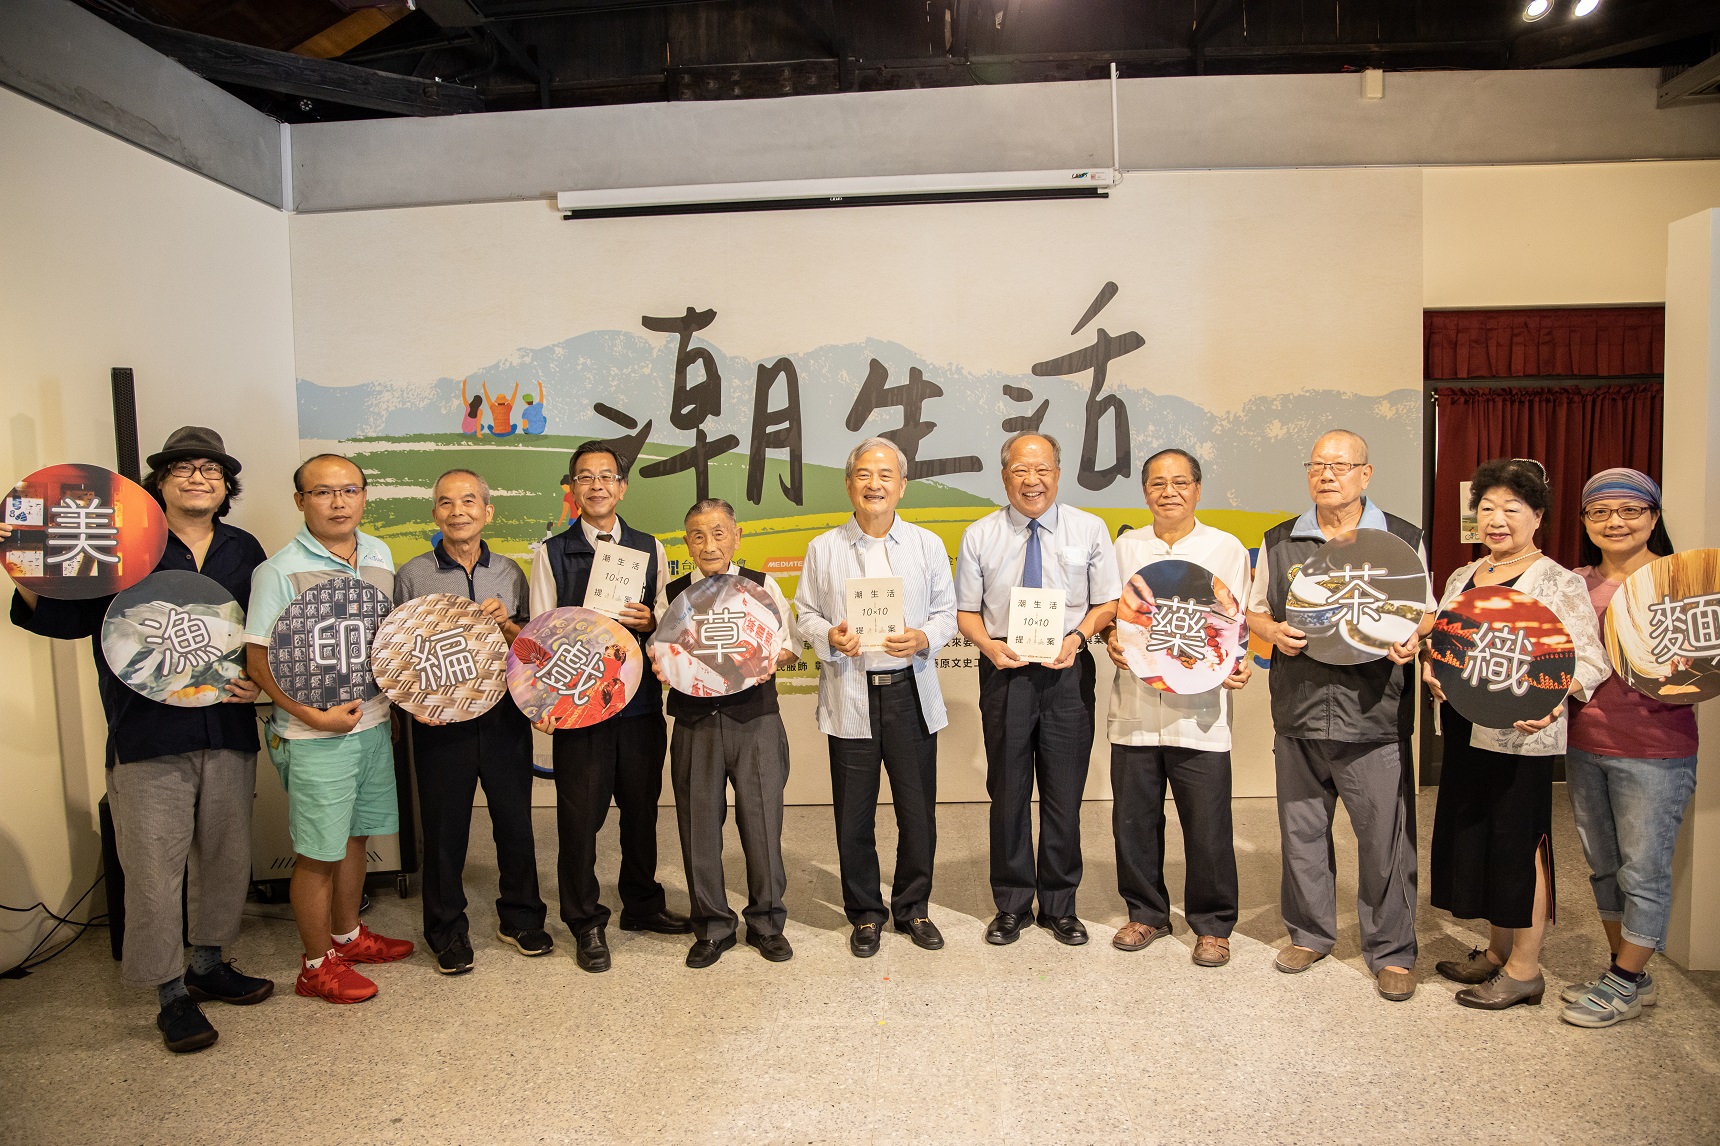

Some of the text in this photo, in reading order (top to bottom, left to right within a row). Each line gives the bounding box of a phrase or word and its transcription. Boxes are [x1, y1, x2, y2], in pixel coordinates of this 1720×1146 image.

[594, 281, 1145, 506] 潮生活
[47, 497, 120, 563] 美
[602, 553, 640, 571] 潮生活
[767, 560, 804, 568] MEDIATE
[854, 589, 896, 599] 潮生活
[1325, 562, 1389, 626] 茶
[691, 608, 747, 664] 草
[1017, 599, 1058, 610] 潮生活
[1147, 596, 1211, 660] 藥
[1648, 592, 1720, 664] 麵
[143, 608, 222, 677] 漁
[314, 617, 366, 674] 印
[410, 627, 478, 690] 編
[535, 640, 605, 705] 戲
[1461, 622, 1533, 696] 織
